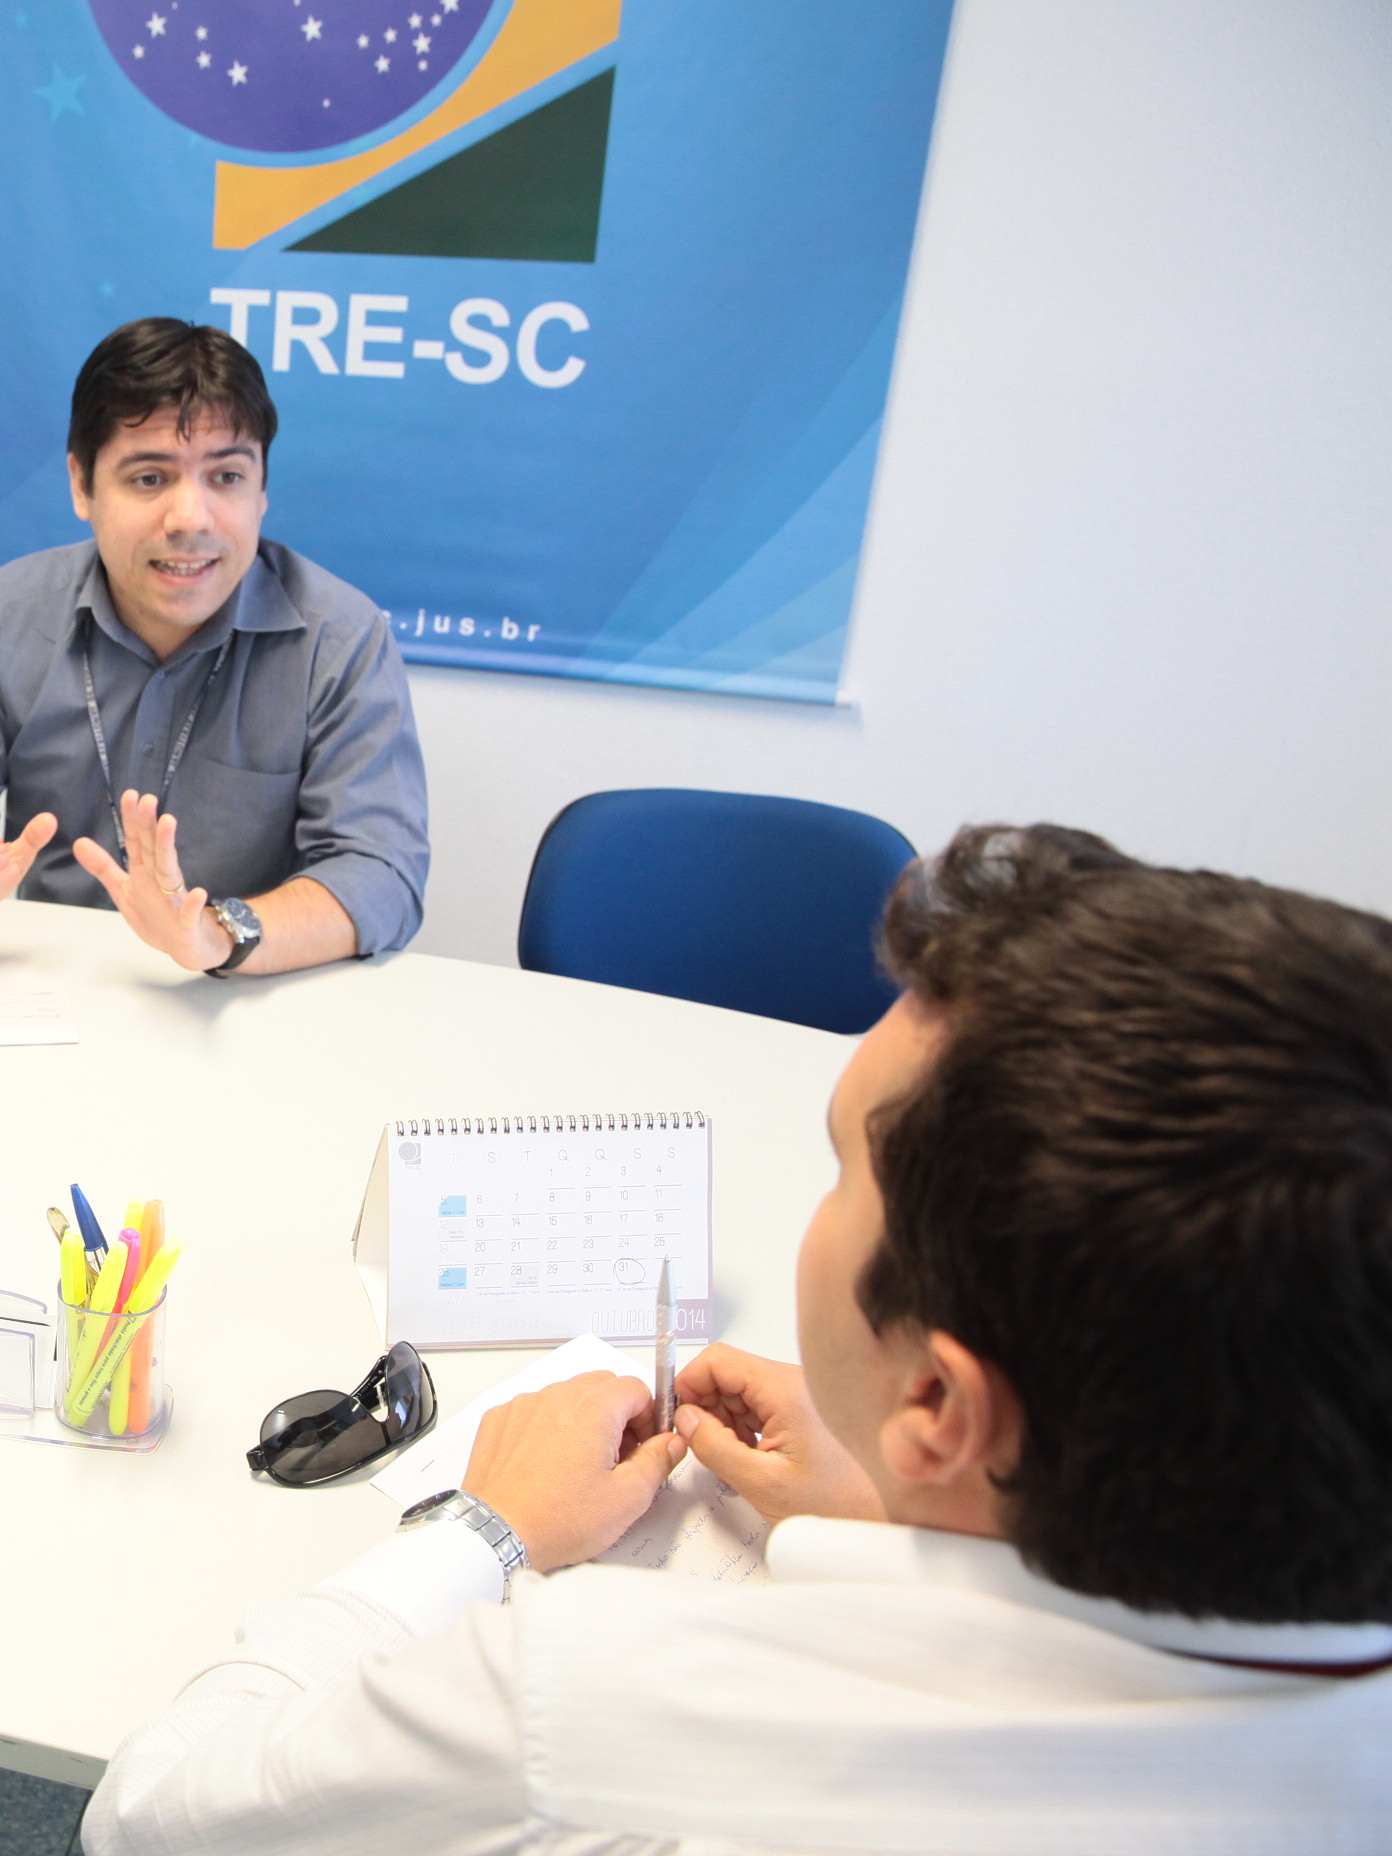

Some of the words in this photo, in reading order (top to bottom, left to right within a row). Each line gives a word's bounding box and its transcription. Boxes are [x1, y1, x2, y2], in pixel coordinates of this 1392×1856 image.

[210, 288, 590, 389] TRE-SC
[488, 1152, 496, 1163] S
[524, 1151, 531, 1161] T
[558, 1150, 569, 1161] Q
[595, 1149, 606, 1160] Q
[633, 1148, 641, 1159] S
[667, 1147, 675, 1158] S
[620, 1190, 628, 1200] 10
[655, 1189, 662, 1198] 11
[476, 1218, 484, 1228] 13
[512, 1218, 520, 1226] 14
[549, 1216, 557, 1225] 15
[584, 1215, 592, 1224] 16
[620, 1214, 628, 1223] 17
[655, 1213, 663, 1222] 18
[475, 1241, 486, 1252] 20
[511, 1240, 520, 1251] 21
[547, 1240, 557, 1250] 22
[584, 1239, 594, 1248] 23
[619, 1238, 629, 1247] 24
[654, 1237, 665, 1246] 25
[474, 1266, 485, 1276] 27
[511, 1266, 521, 1275] 28
[547, 1264, 557, 1274] 29
[583, 1263, 593, 1273] 30
[619, 1262, 628, 1271] 31
[591, 1310, 655, 1333] OUTUBRO
[675, 1308, 706, 1331] 014
